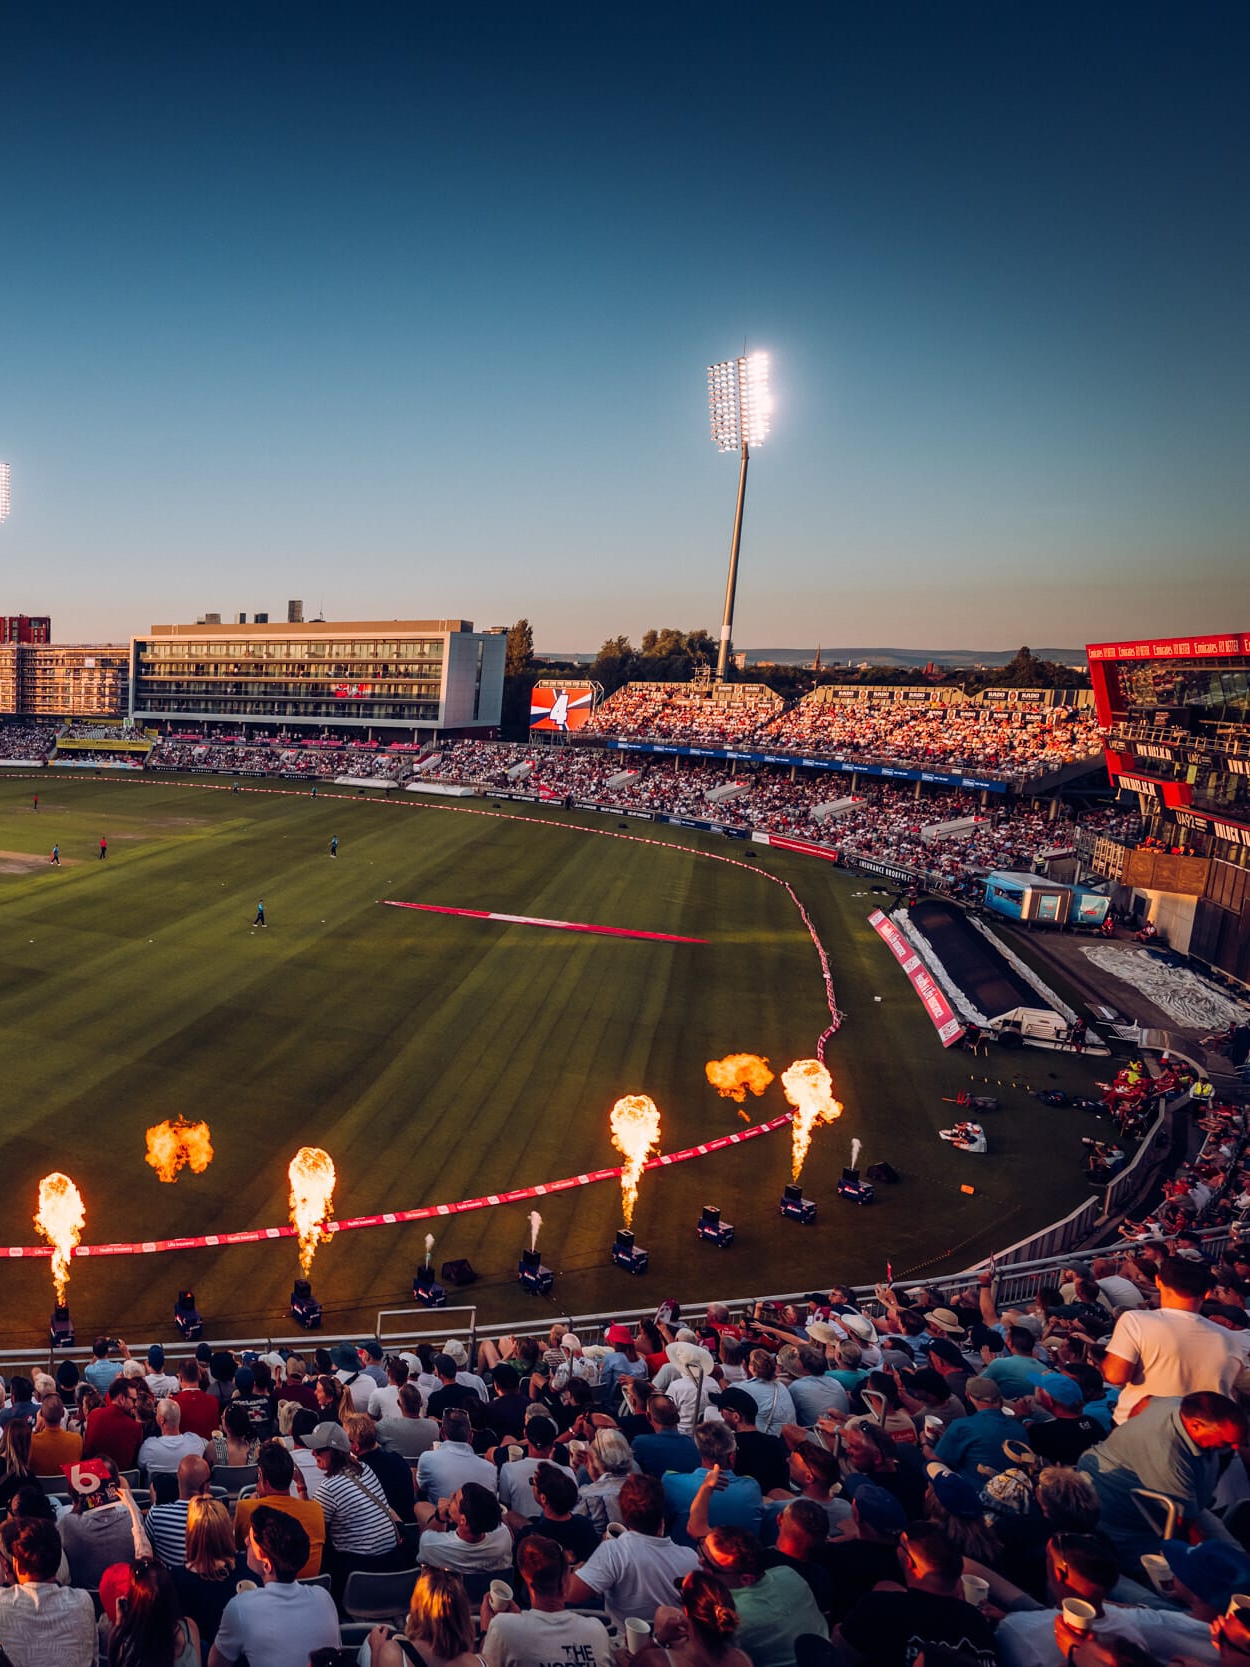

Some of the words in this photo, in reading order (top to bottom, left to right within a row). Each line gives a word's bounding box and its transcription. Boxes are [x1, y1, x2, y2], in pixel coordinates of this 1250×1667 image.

[1194, 642, 1218, 654] Emirates
[550, 694, 569, 725] 4
[1176, 810, 1196, 830] UA92
[859, 860, 885, 875] INSURANCE
[70, 1464, 101, 1495] 6
[561, 1644, 595, 1662] THE
